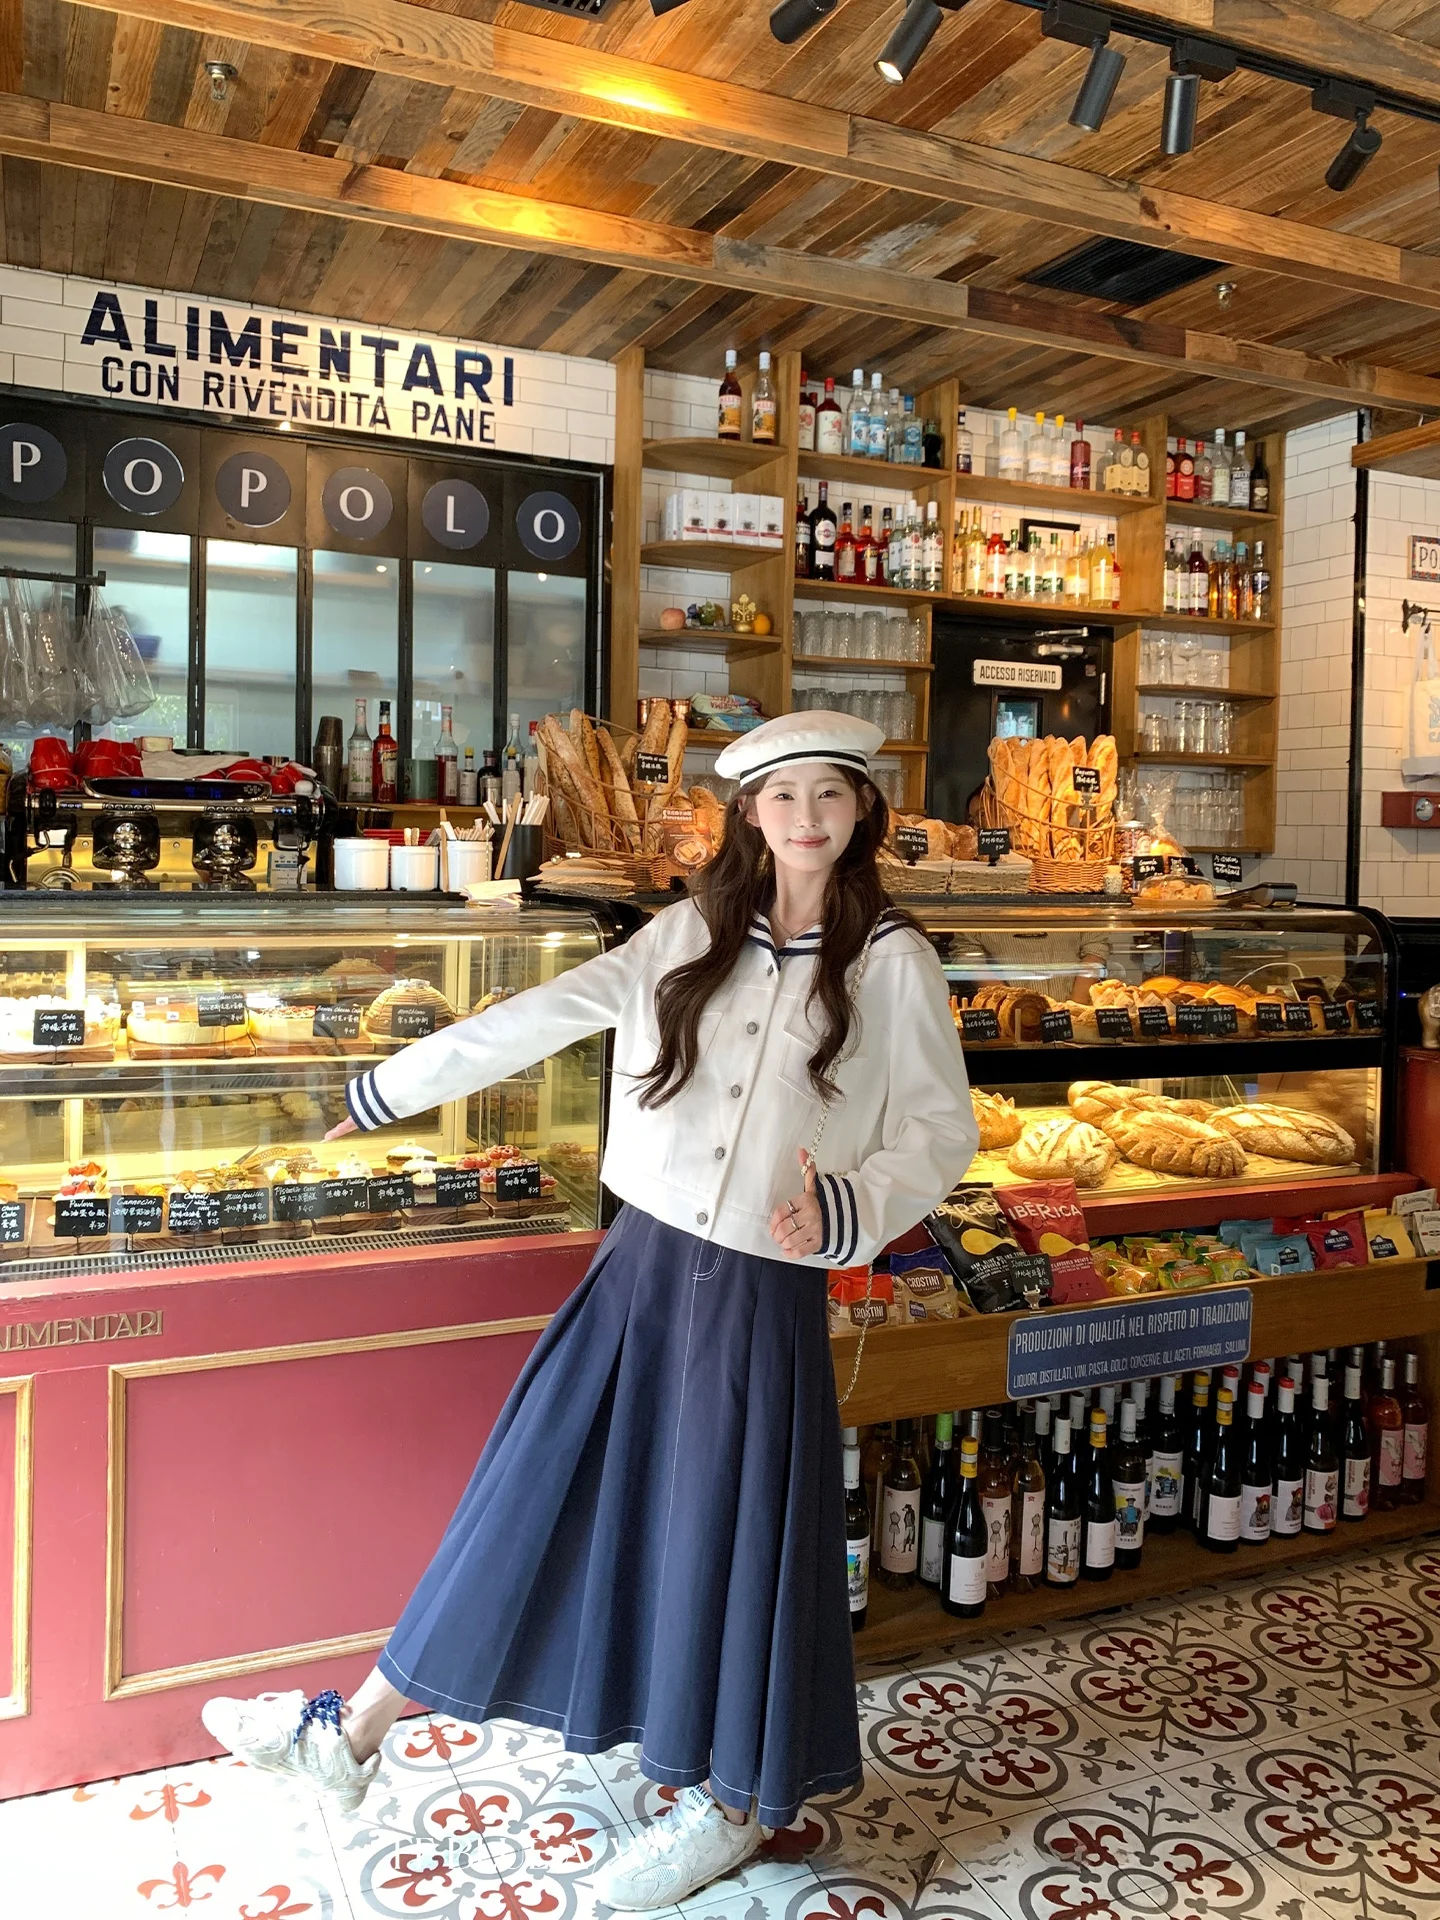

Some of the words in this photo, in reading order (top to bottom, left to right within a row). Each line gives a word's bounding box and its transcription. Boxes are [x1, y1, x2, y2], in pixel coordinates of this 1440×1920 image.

[80, 291, 514, 407] ALIMENTARI
[102, 356, 180, 402] CON
[203, 370, 391, 431] RIVENDITA
[412, 400, 496, 444] PANE
[1419, 546, 1440, 569] PO
[979, 665, 1016, 681] ACCESSO
[1017, 667, 1057, 684] RISERVATO
[906, 1274, 941, 1288] CROSTINI
[0, 1309, 164, 1351] LIMENTARI
[1075, 1323, 1086, 1346] DI
[1128, 1319, 1145, 1339] NEL
[1148, 1309, 1187, 1335] RISPETTO
[1189, 1307, 1200, 1329] DI
[1202, 1300, 1249, 1327] TRADIZIONI
[689, 1789, 705, 1807] miu
